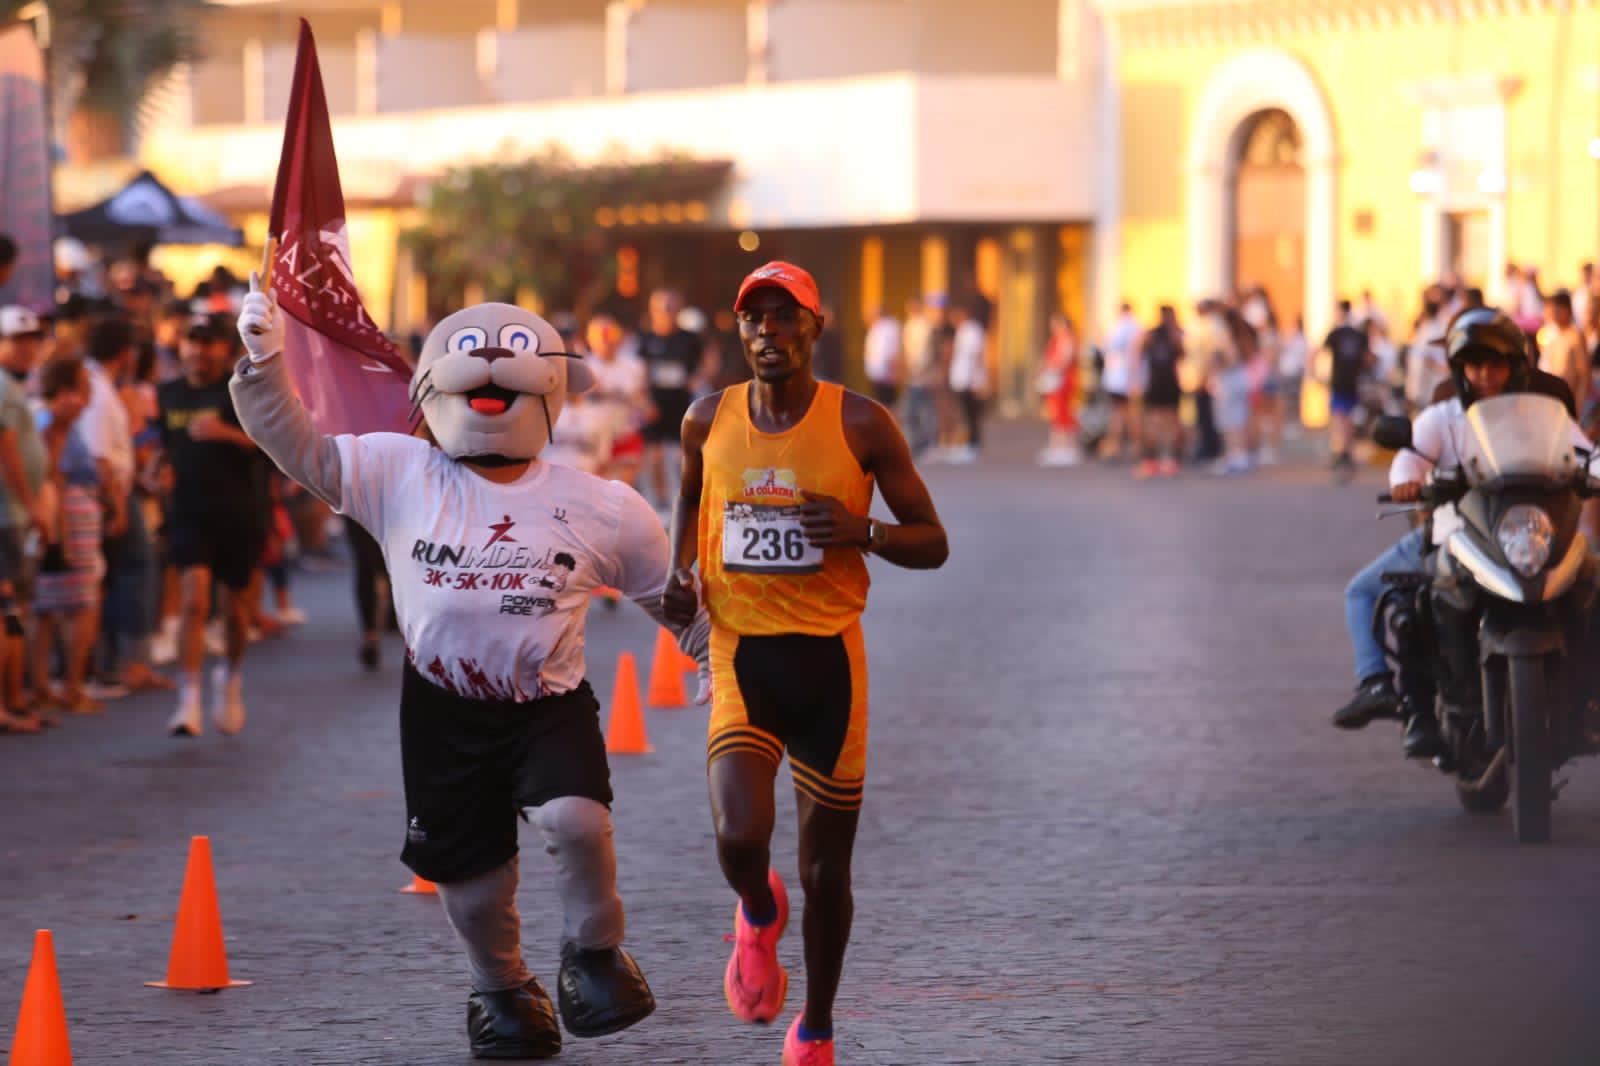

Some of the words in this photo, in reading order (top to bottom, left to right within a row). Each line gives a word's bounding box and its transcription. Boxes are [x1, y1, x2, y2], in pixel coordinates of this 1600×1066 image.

[745, 487, 754, 497] LA
[411, 539, 465, 568] RUN
[742, 527, 805, 561] 236
[502, 594, 556, 607] POWER
